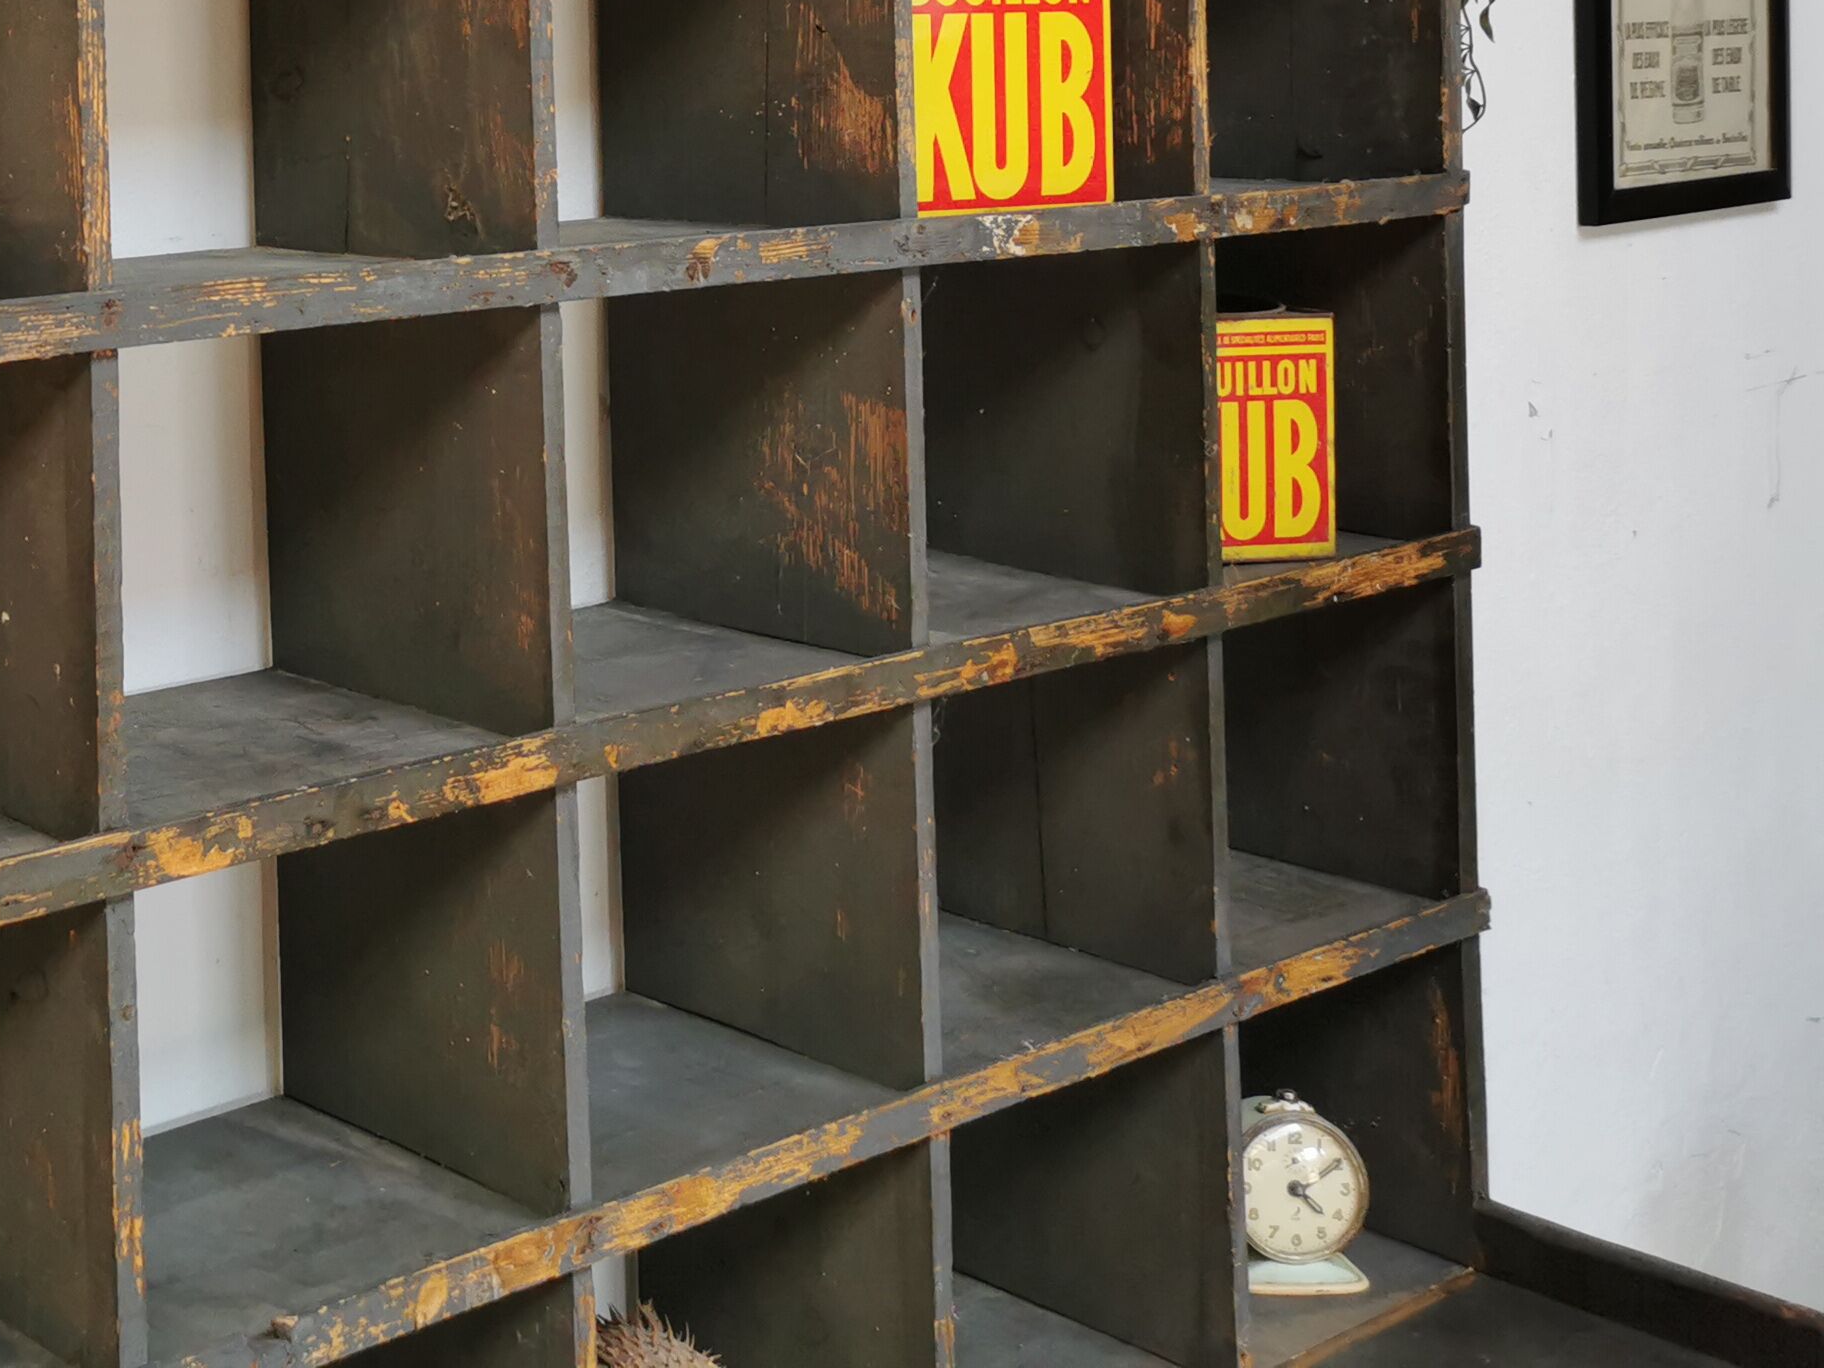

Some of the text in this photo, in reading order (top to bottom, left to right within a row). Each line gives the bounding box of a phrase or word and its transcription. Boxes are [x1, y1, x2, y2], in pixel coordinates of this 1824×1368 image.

[912, 11, 1095, 202] KUB
[1216, 359, 1317, 397] UILLON
[1220, 399, 1321, 541] UB
[1287, 1133, 1303, 1145] 12
[1248, 1158, 1263, 1171] 10
[1340, 1183, 1350, 1196] 3
[1248, 1208, 1259, 1220] 8
[1332, 1209, 1344, 1221] 4
[1269, 1225, 1280, 1238] 7
[1316, 1227, 1327, 1239] 5
[1291, 1234, 1302, 1246] 6
